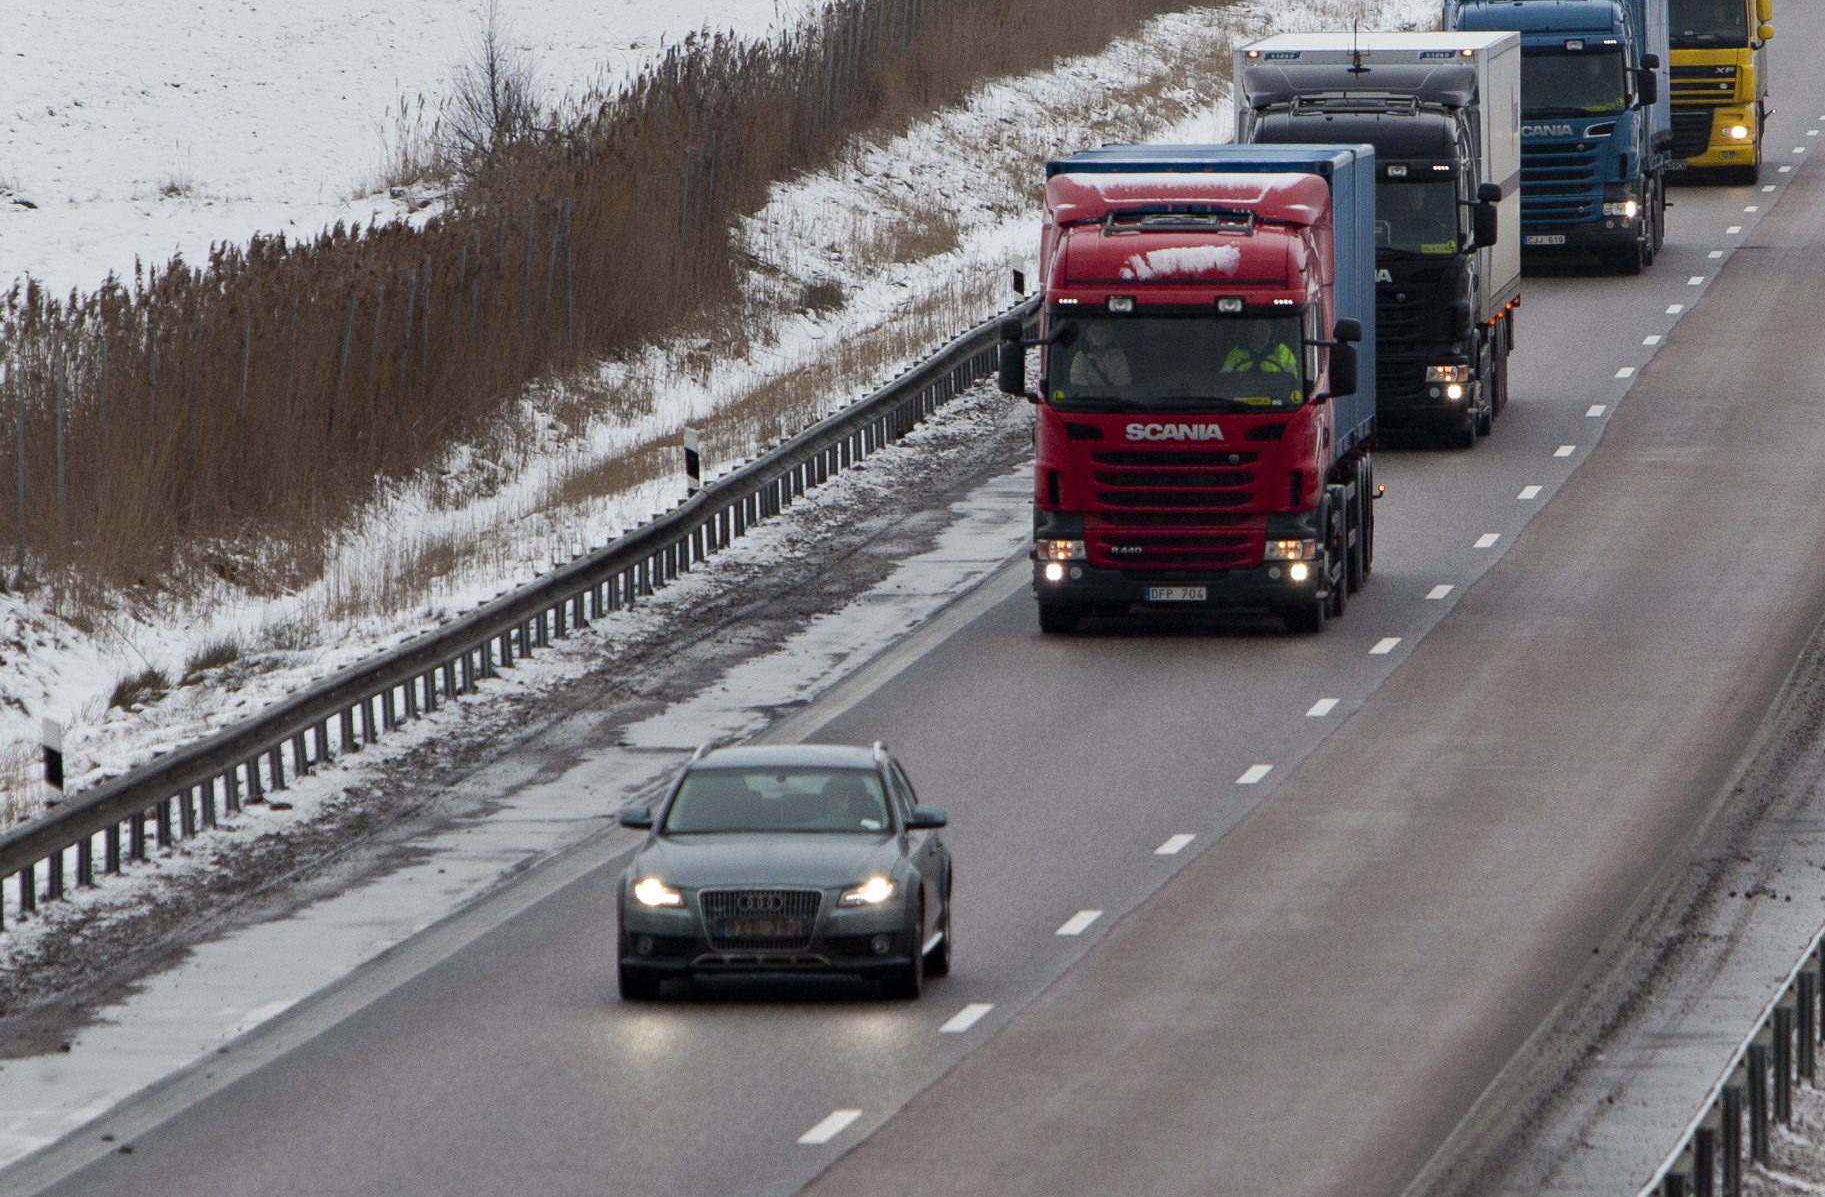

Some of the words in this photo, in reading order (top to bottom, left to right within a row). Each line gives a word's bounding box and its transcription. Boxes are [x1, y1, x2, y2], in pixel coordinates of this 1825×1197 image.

[1714, 66, 1735, 74] XF
[1520, 124, 1573, 138] CANIA
[1125, 422, 1225, 441] SCANIA
[1120, 546, 1143, 554] 440
[1151, 587, 1173, 600] DFP
[1181, 587, 1204, 600] 704
